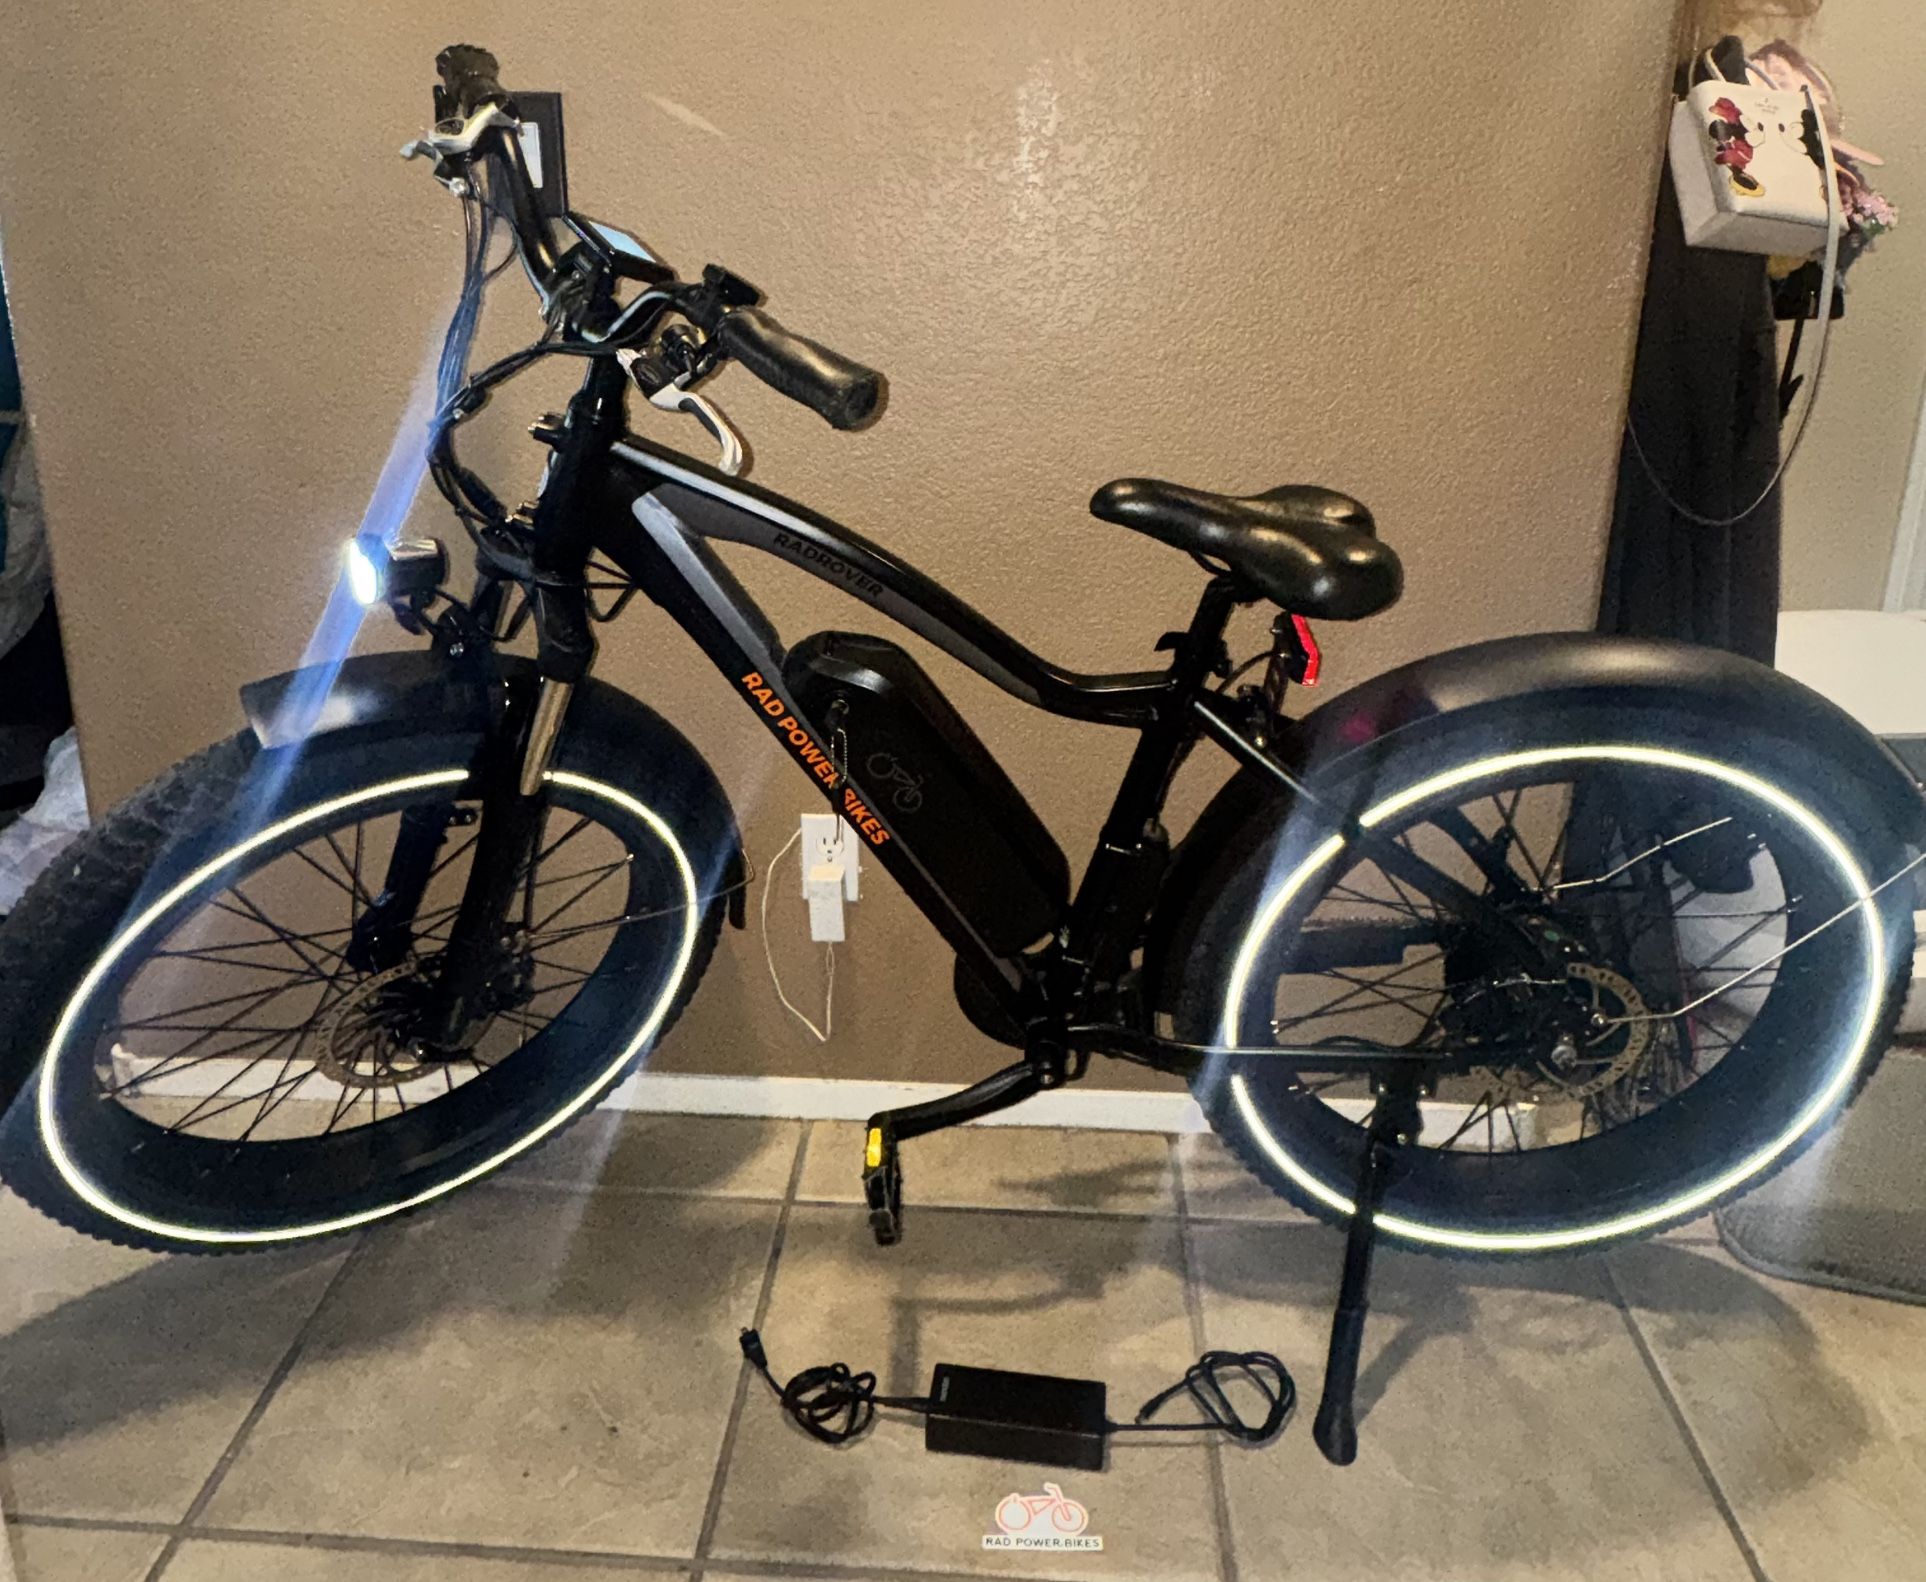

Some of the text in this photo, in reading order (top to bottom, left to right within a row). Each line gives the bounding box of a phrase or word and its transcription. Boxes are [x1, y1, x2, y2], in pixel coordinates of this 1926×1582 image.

[773, 533, 884, 597] RADROVER
[741, 671, 785, 717] RAD
[985, 1537, 1100, 1548] RAD POWER BIKES
